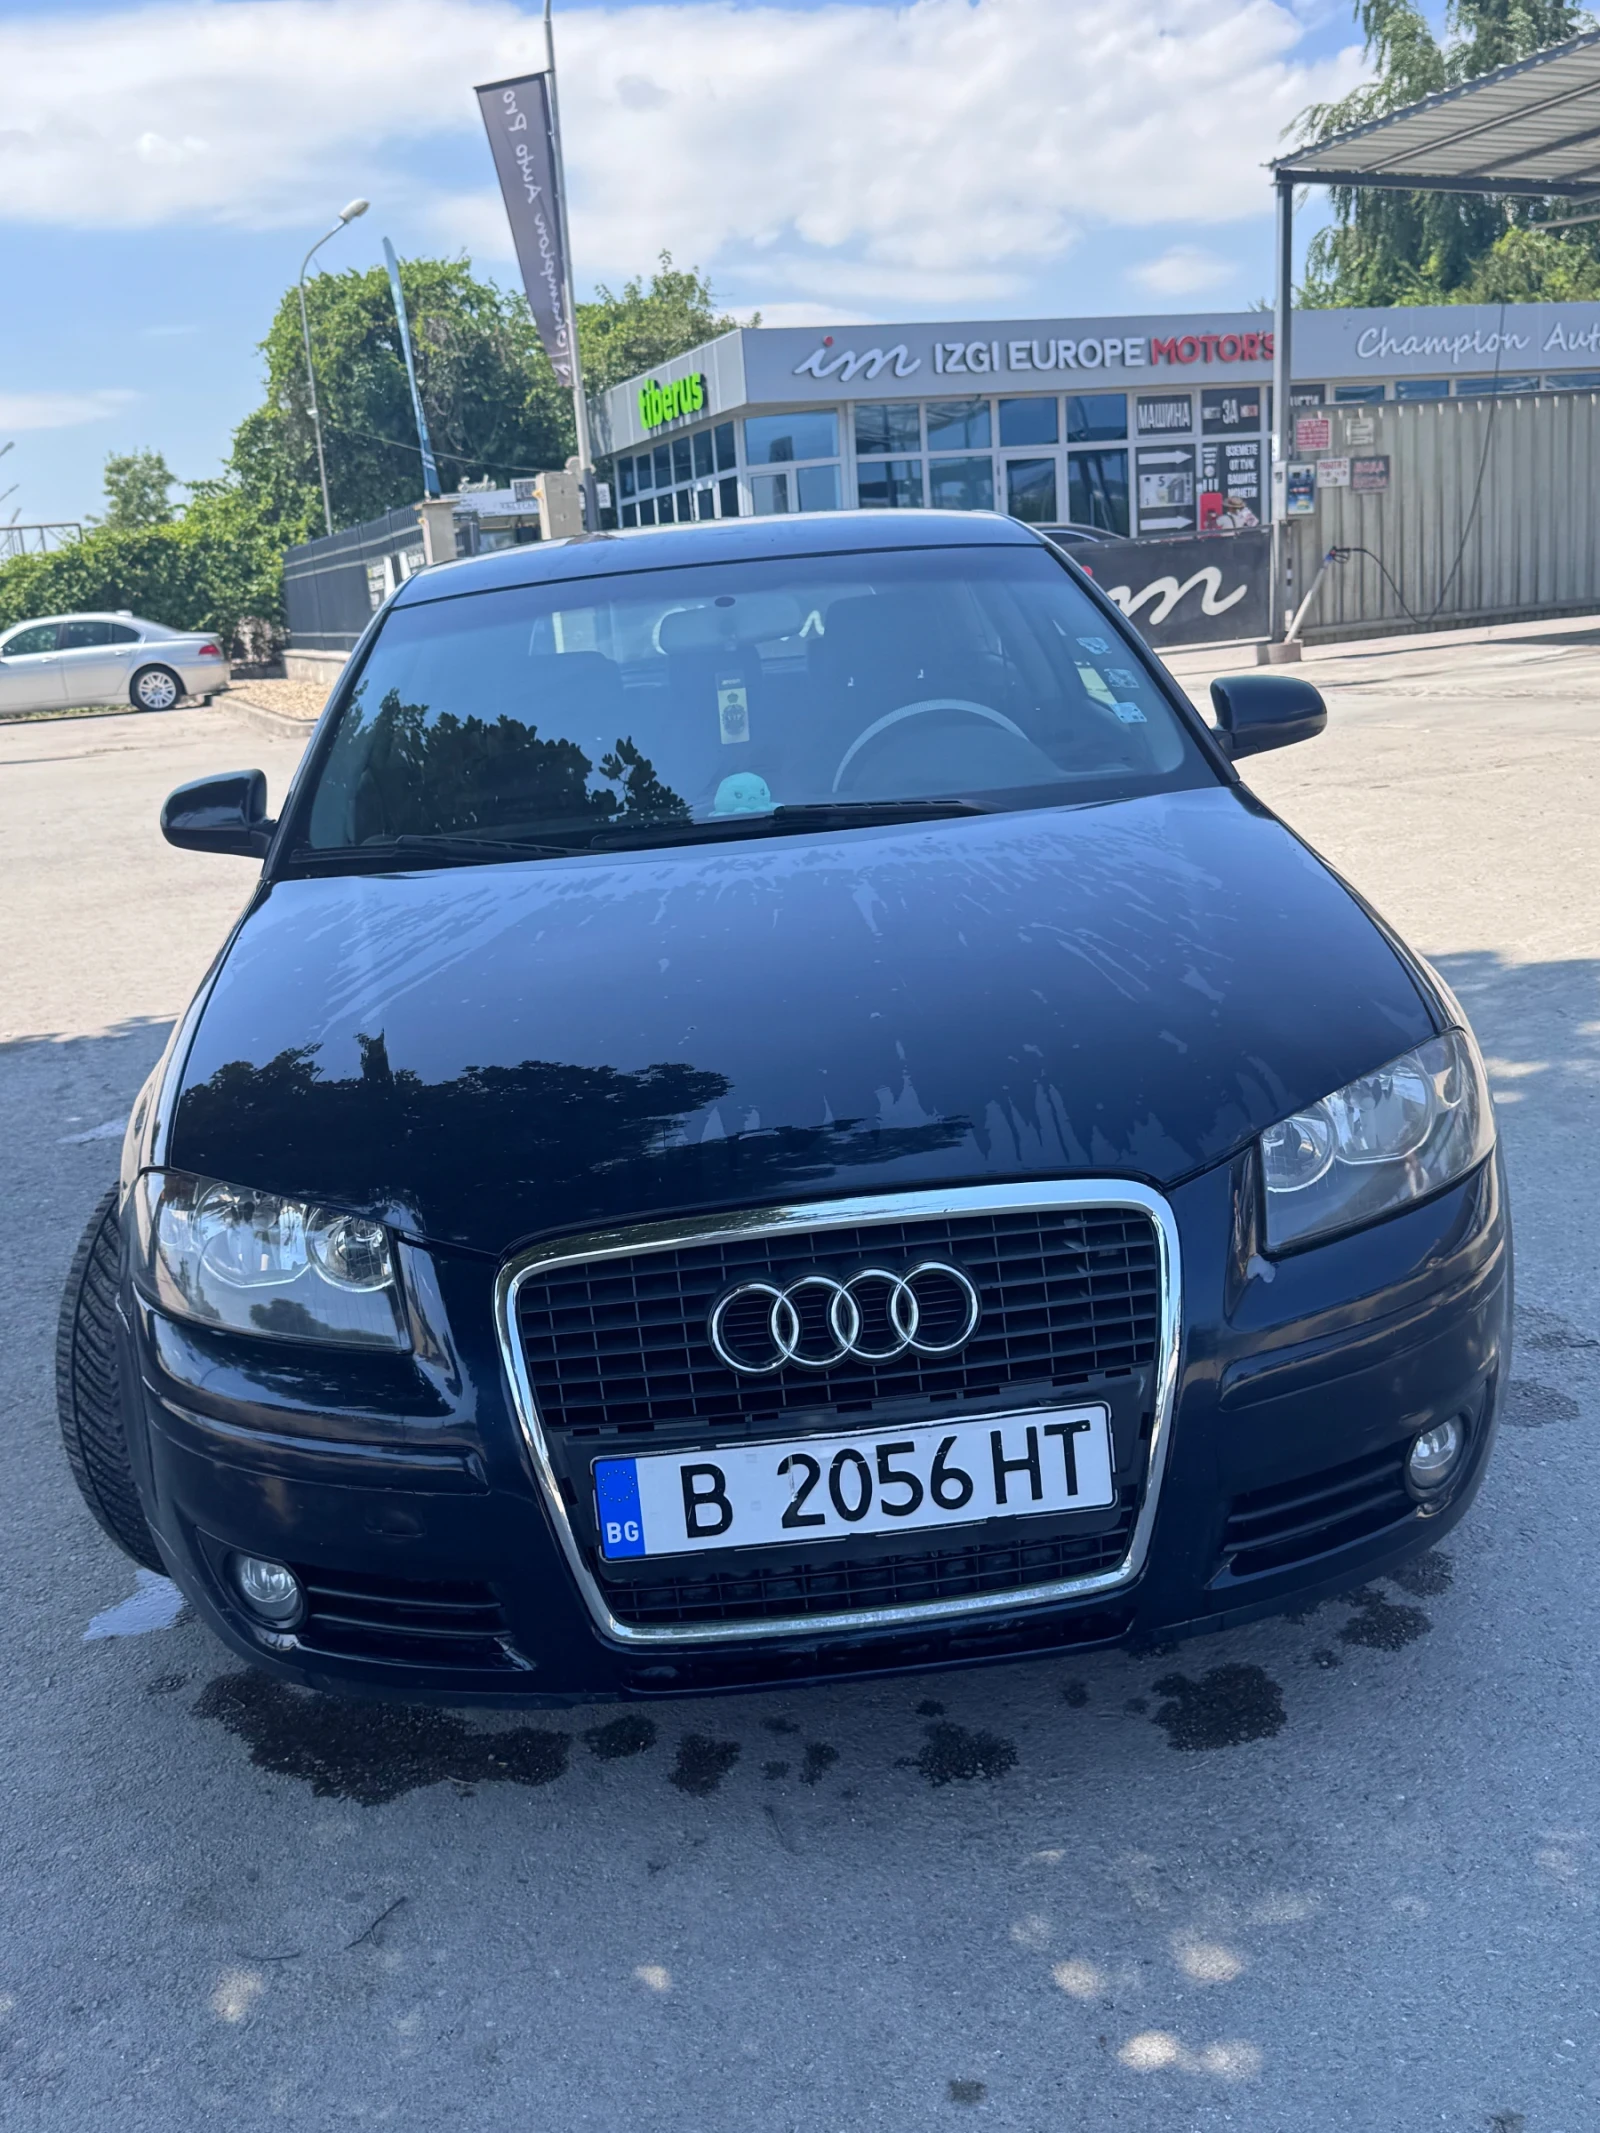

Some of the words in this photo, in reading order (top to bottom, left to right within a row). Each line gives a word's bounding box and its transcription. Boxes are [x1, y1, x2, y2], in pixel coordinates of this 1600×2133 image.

[793, 335, 921, 382] im
[934, 340, 1000, 374] IZGI
[1008, 337, 1146, 370] EUROPE
[1356, 327, 1530, 364] Champion
[1543, 321, 1600, 353] Aut
[637, 371, 705, 431] tiberus
[1138, 402, 1190, 428] МАШИНА
[1222, 399, 1239, 425] ЗА
[680, 1462, 733, 1538] B
[776, 1435, 973, 1529] 2056
[990, 1420, 1091, 1505] HT
[606, 1520, 640, 1544] BG
